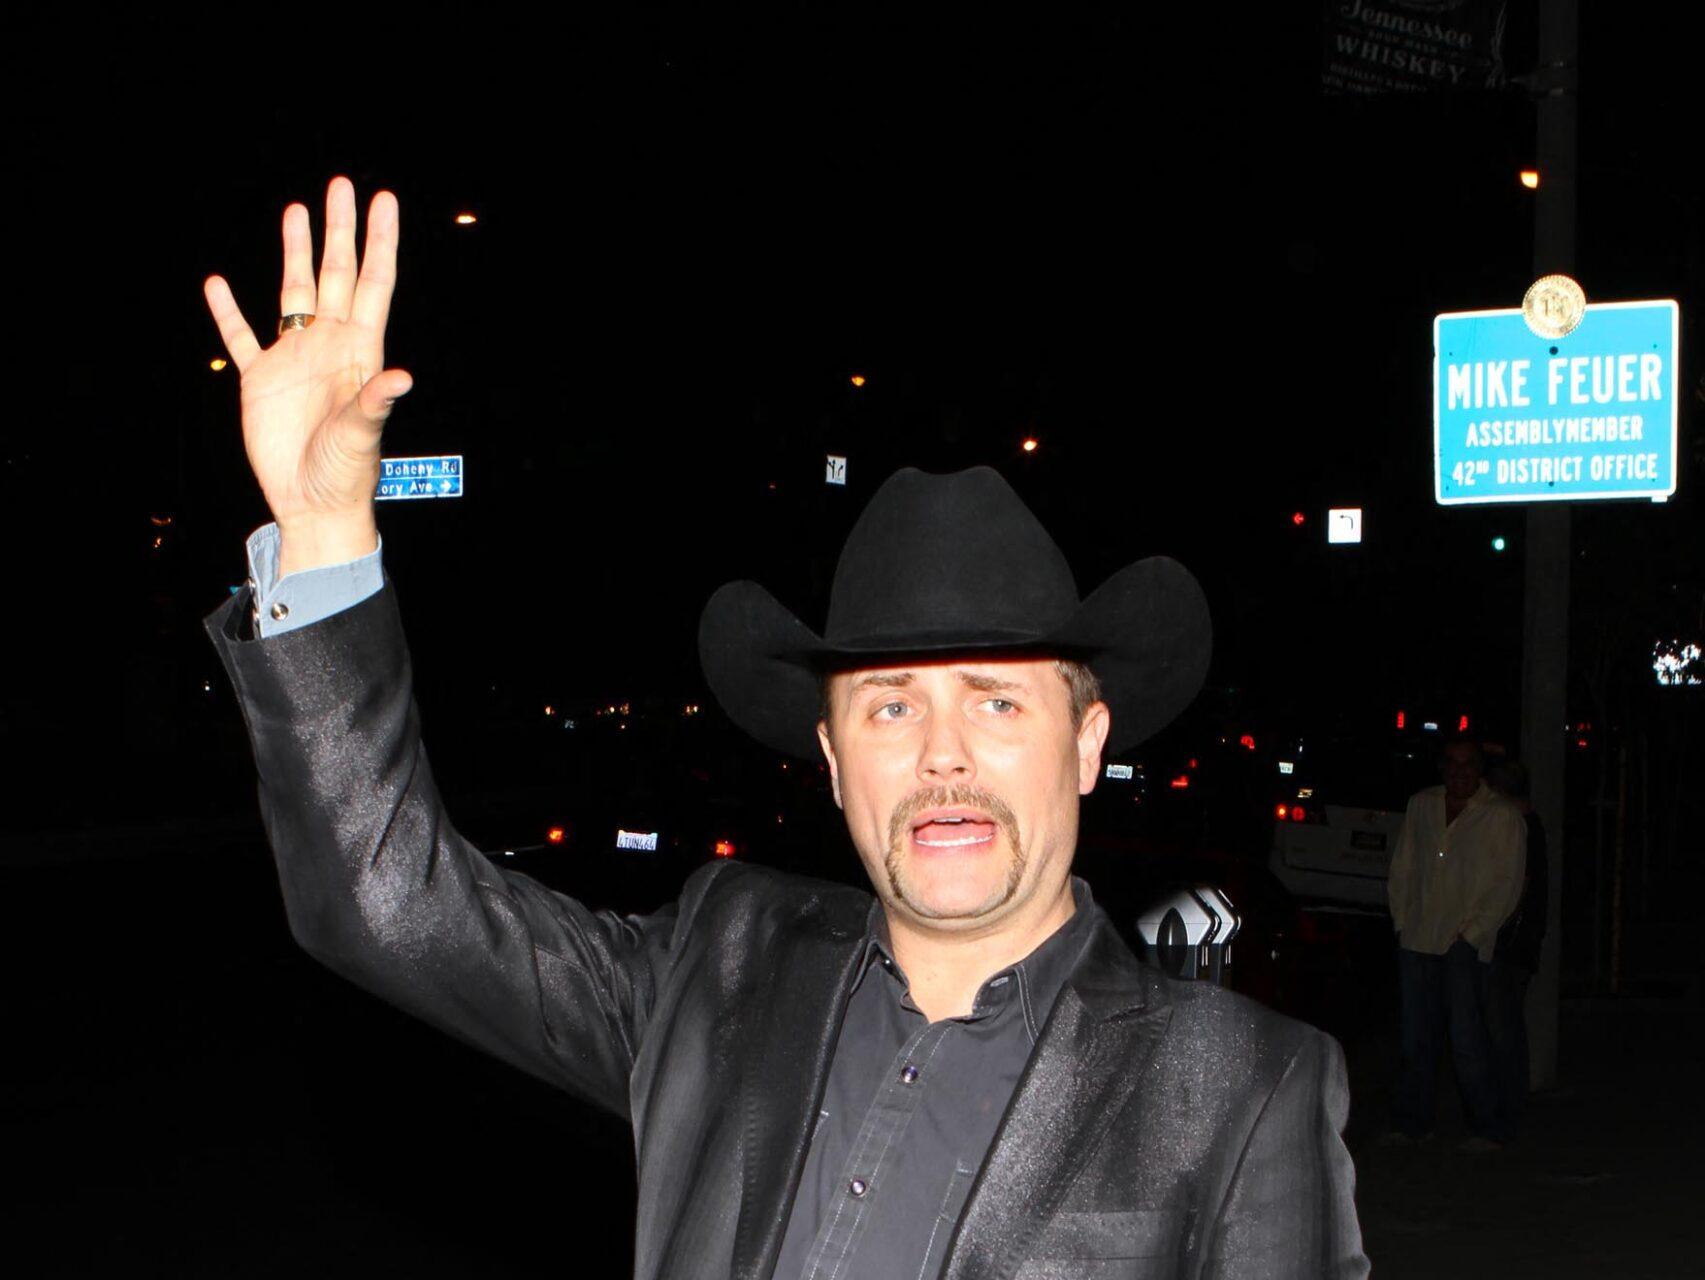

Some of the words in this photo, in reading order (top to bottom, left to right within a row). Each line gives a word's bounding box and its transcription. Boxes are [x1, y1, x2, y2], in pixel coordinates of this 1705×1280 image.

[1336, 34, 1465, 84] WHISKEY
[1448, 360, 1531, 411] MIKE
[1548, 353, 1663, 406] FEUER
[1465, 415, 1643, 448] ASSEMBLYMEMBER
[385, 463, 433, 476] Doheny
[1497, 456, 1583, 484] DISTRICT
[1590, 453, 1658, 481] OFFICE
[381, 484, 403, 496] ory
[410, 480, 433, 494] Ave
